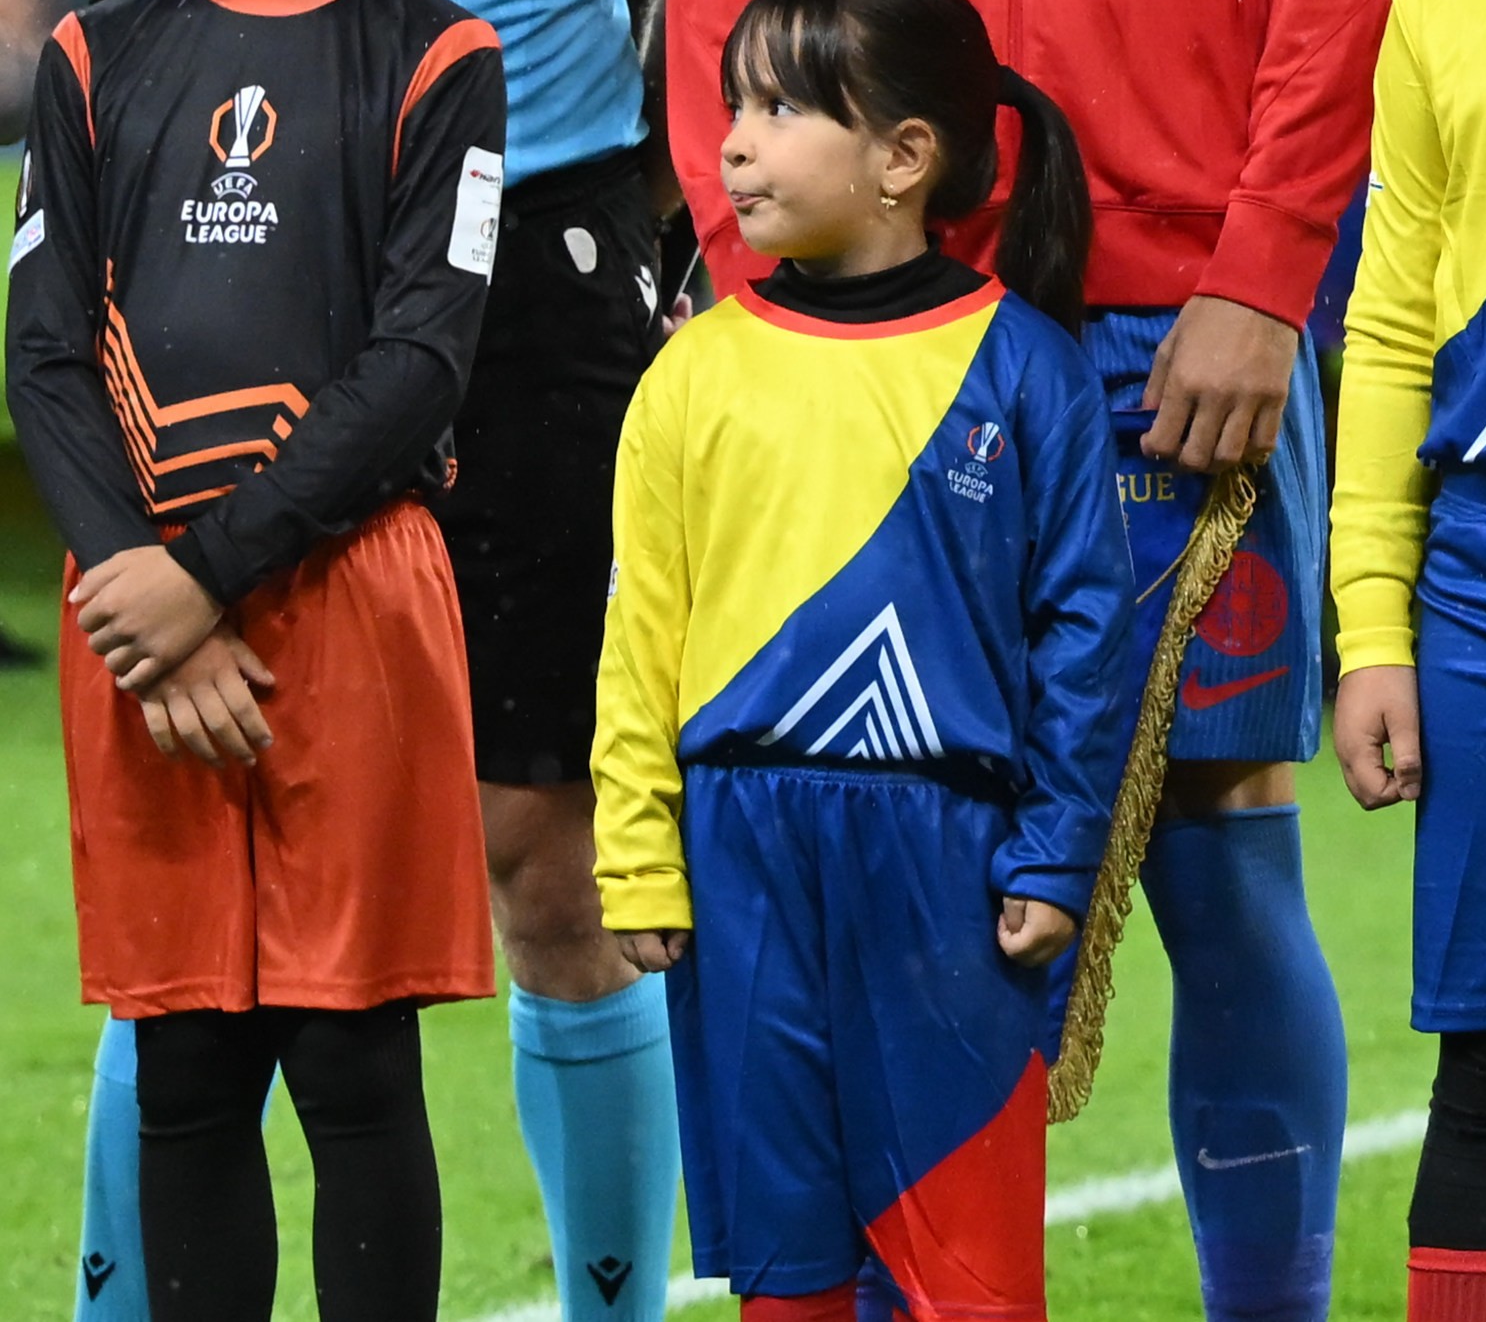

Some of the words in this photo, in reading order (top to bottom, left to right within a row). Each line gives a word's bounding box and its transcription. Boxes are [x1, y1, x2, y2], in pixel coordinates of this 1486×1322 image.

[212, 176, 254, 197] UEFA
[181, 199, 279, 224] EUROPA
[185, 224, 268, 245] LEAGUE
[947, 469, 994, 496] EUROPA
[949, 481, 987, 504] LEAGUE
